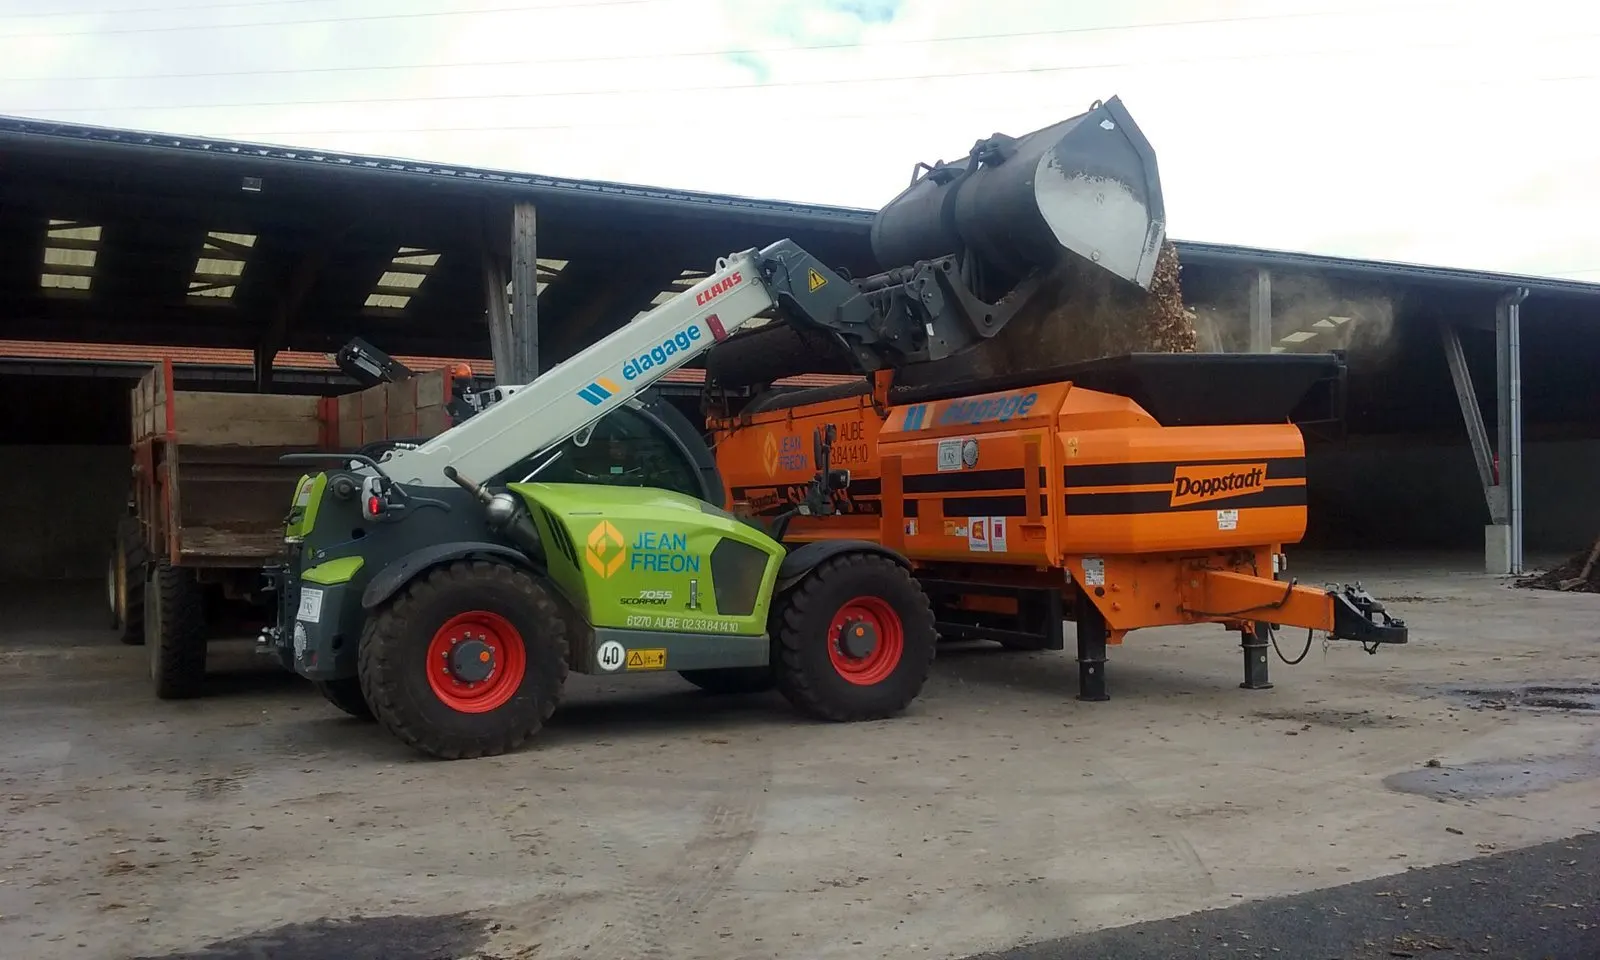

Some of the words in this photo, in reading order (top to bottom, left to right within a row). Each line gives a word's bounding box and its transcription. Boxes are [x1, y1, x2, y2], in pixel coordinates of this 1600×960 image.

[695, 271, 743, 307] CLAAS
[622, 324, 701, 381] élagage
[840, 421, 865, 440] AUBE
[1174, 468, 1263, 497] Doppstadt
[632, 532, 687, 551] JEAN
[631, 553, 700, 573] FREON
[640, 590, 673, 599] 7055
[627, 615, 651, 627] 61270
[654, 617, 679, 628] AUBE
[602, 646, 620, 666] 40
